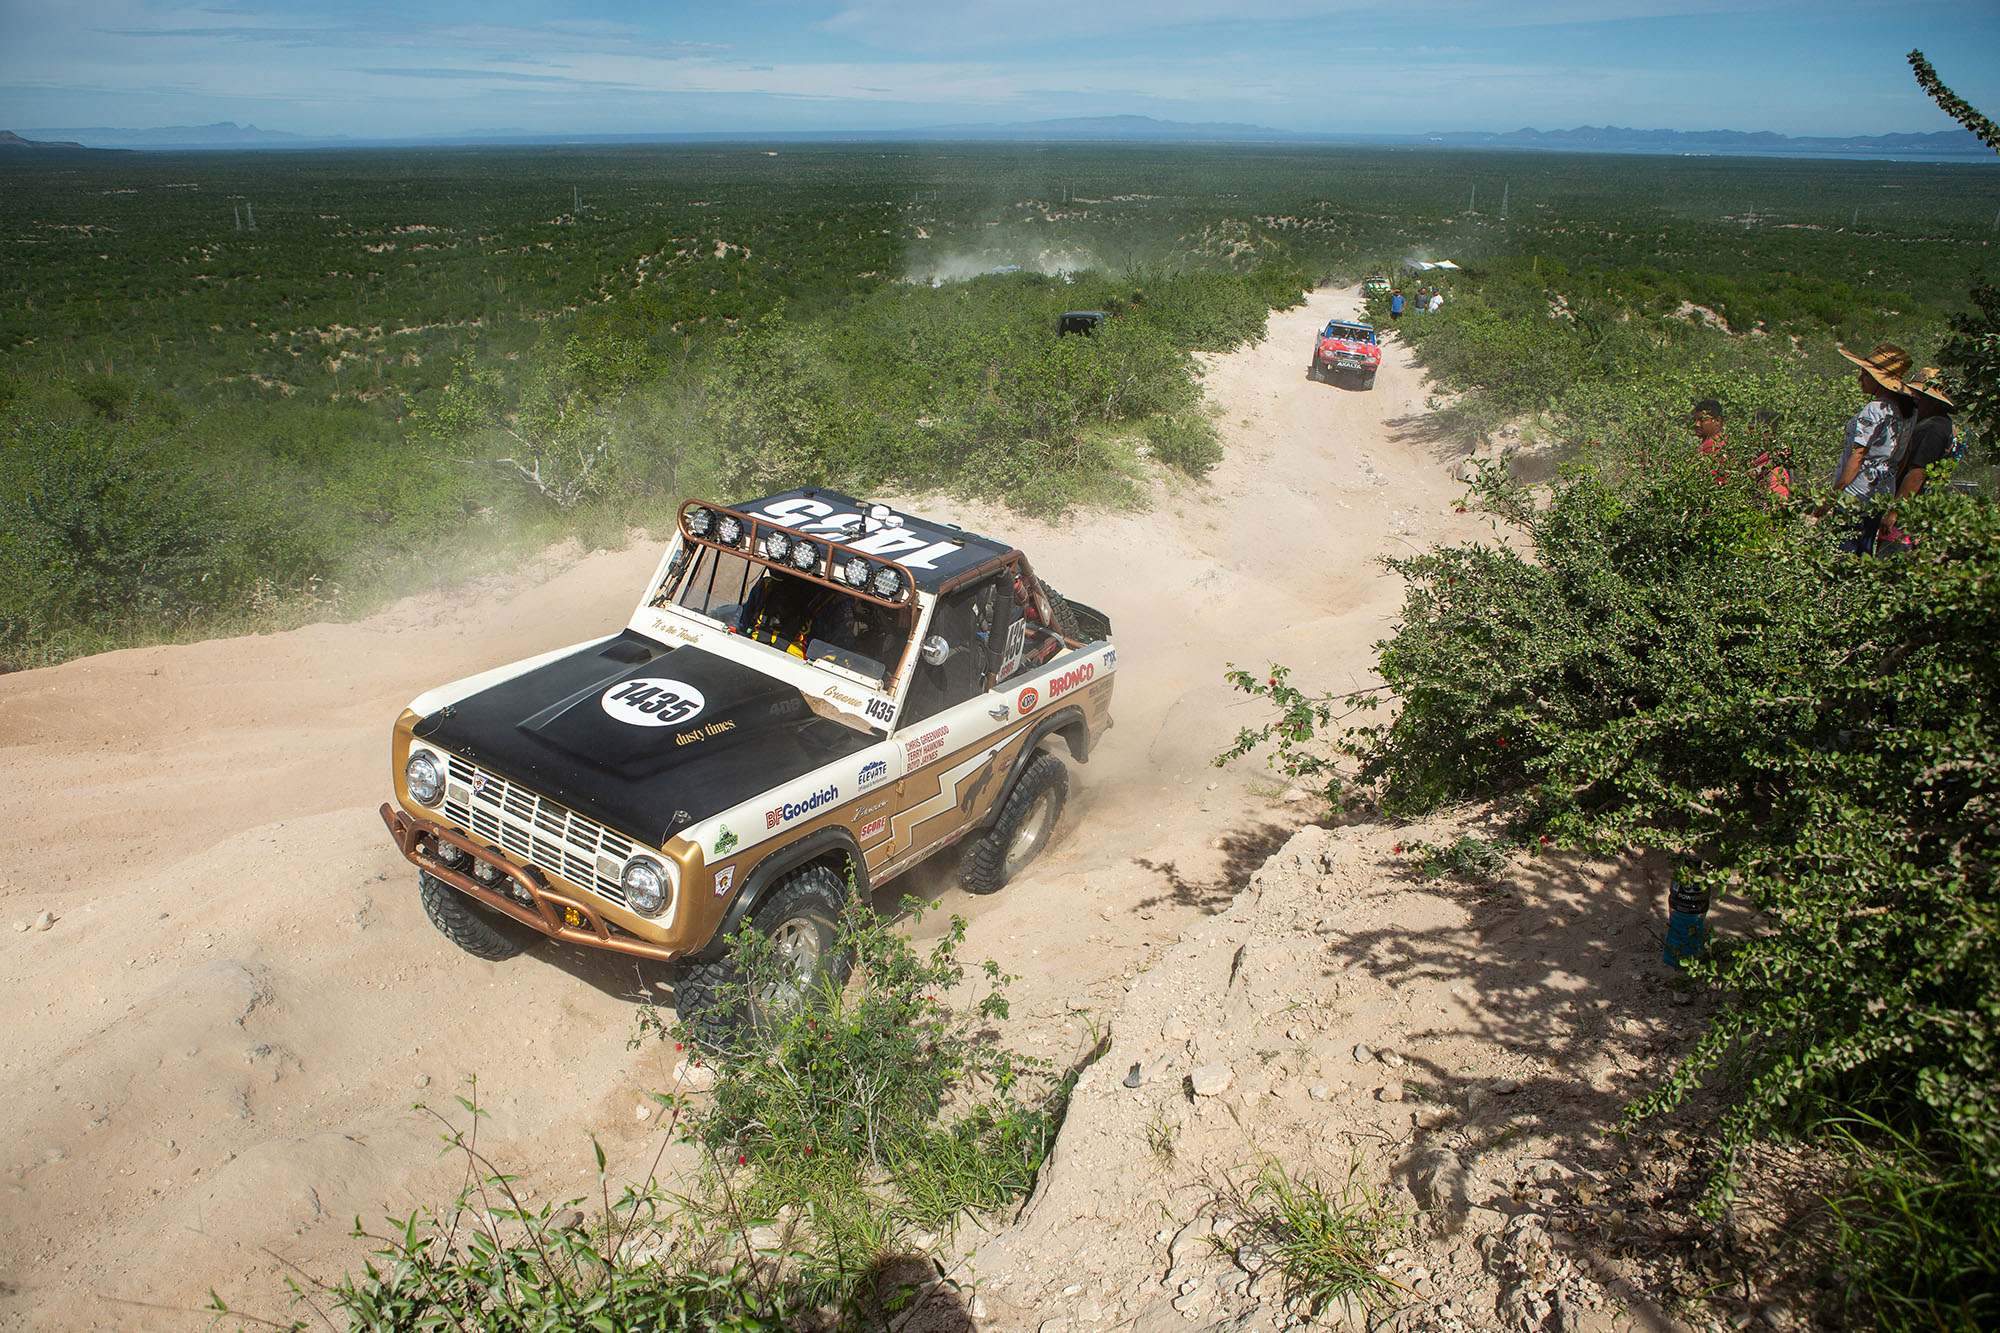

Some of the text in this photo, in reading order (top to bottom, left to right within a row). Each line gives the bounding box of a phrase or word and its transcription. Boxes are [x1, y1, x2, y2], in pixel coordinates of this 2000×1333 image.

[1337, 361, 1362, 370] AXALTA
[747, 498, 962, 570] 1435
[1049, 663, 1094, 697] BRONCO
[610, 682, 700, 722] 1435
[865, 698, 896, 723] 1435
[675, 719, 736, 746] dusty times
[905, 725, 950, 752] CHRIS GREENWOOD
[906, 750, 938, 772] BOYD JAYNES
[907, 737, 945, 762] TERRY HAWKINS
[858, 764, 887, 785] ELEVATE
[766, 785, 839, 830] BFGoodrich
[861, 816, 886, 837] SCORE
